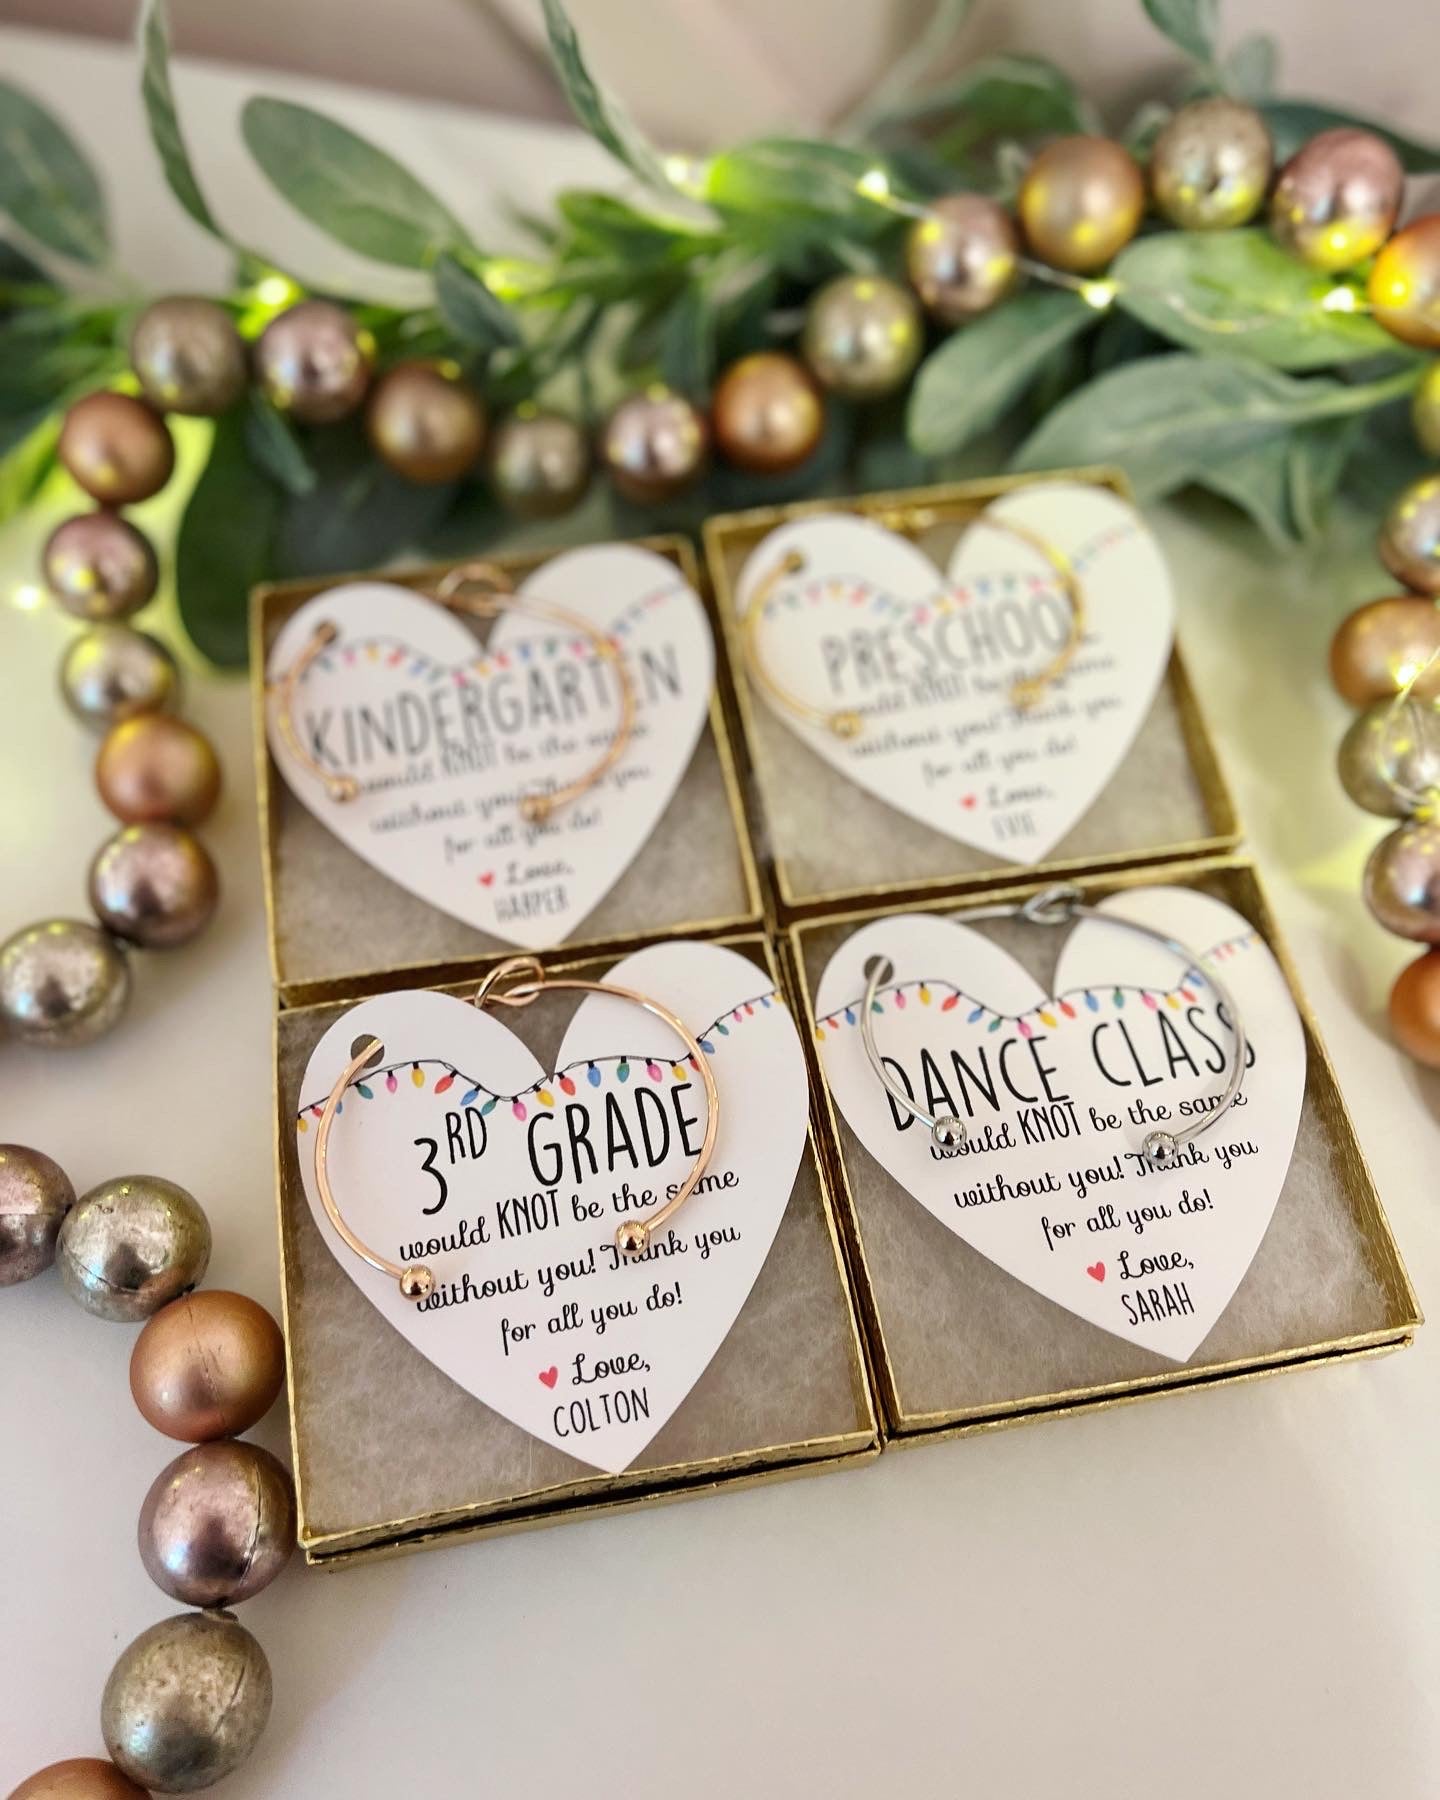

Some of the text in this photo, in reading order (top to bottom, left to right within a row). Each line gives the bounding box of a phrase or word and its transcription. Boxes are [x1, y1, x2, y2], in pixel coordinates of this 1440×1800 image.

[820, 594, 1100, 697] PRESCHOO
[304, 642, 683, 769] KINDERGARTN
[880, 1036, 1070, 1131] DANCE
[527, 1082, 703, 1186] GRADE
[1017, 1101, 1082, 1145] KNOT
[1089, 1107, 1121, 1132] be
[1128, 1099, 1172, 1125] the
[954, 1171, 1062, 1209] without
[1068, 1156, 1125, 1200] you!
[1214, 1140, 1259, 1170] you
[400, 1215, 490, 1261] would
[496, 1189, 560, 1239] KNOT
[572, 1194, 604, 1221] be
[612, 1183, 657, 1212] the
[1041, 1189, 1214, 1251] for all you do!
[537, 1247, 597, 1298] you!
[695, 1226, 741, 1260] you
[1118, 1250, 1195, 1280] Love,
[501, 1282, 684, 1356] for all you do!
[1121, 1281, 1195, 1326] SARAH
[571, 1351, 652, 1387] Love,
[553, 1387, 650, 1438] COLTON
